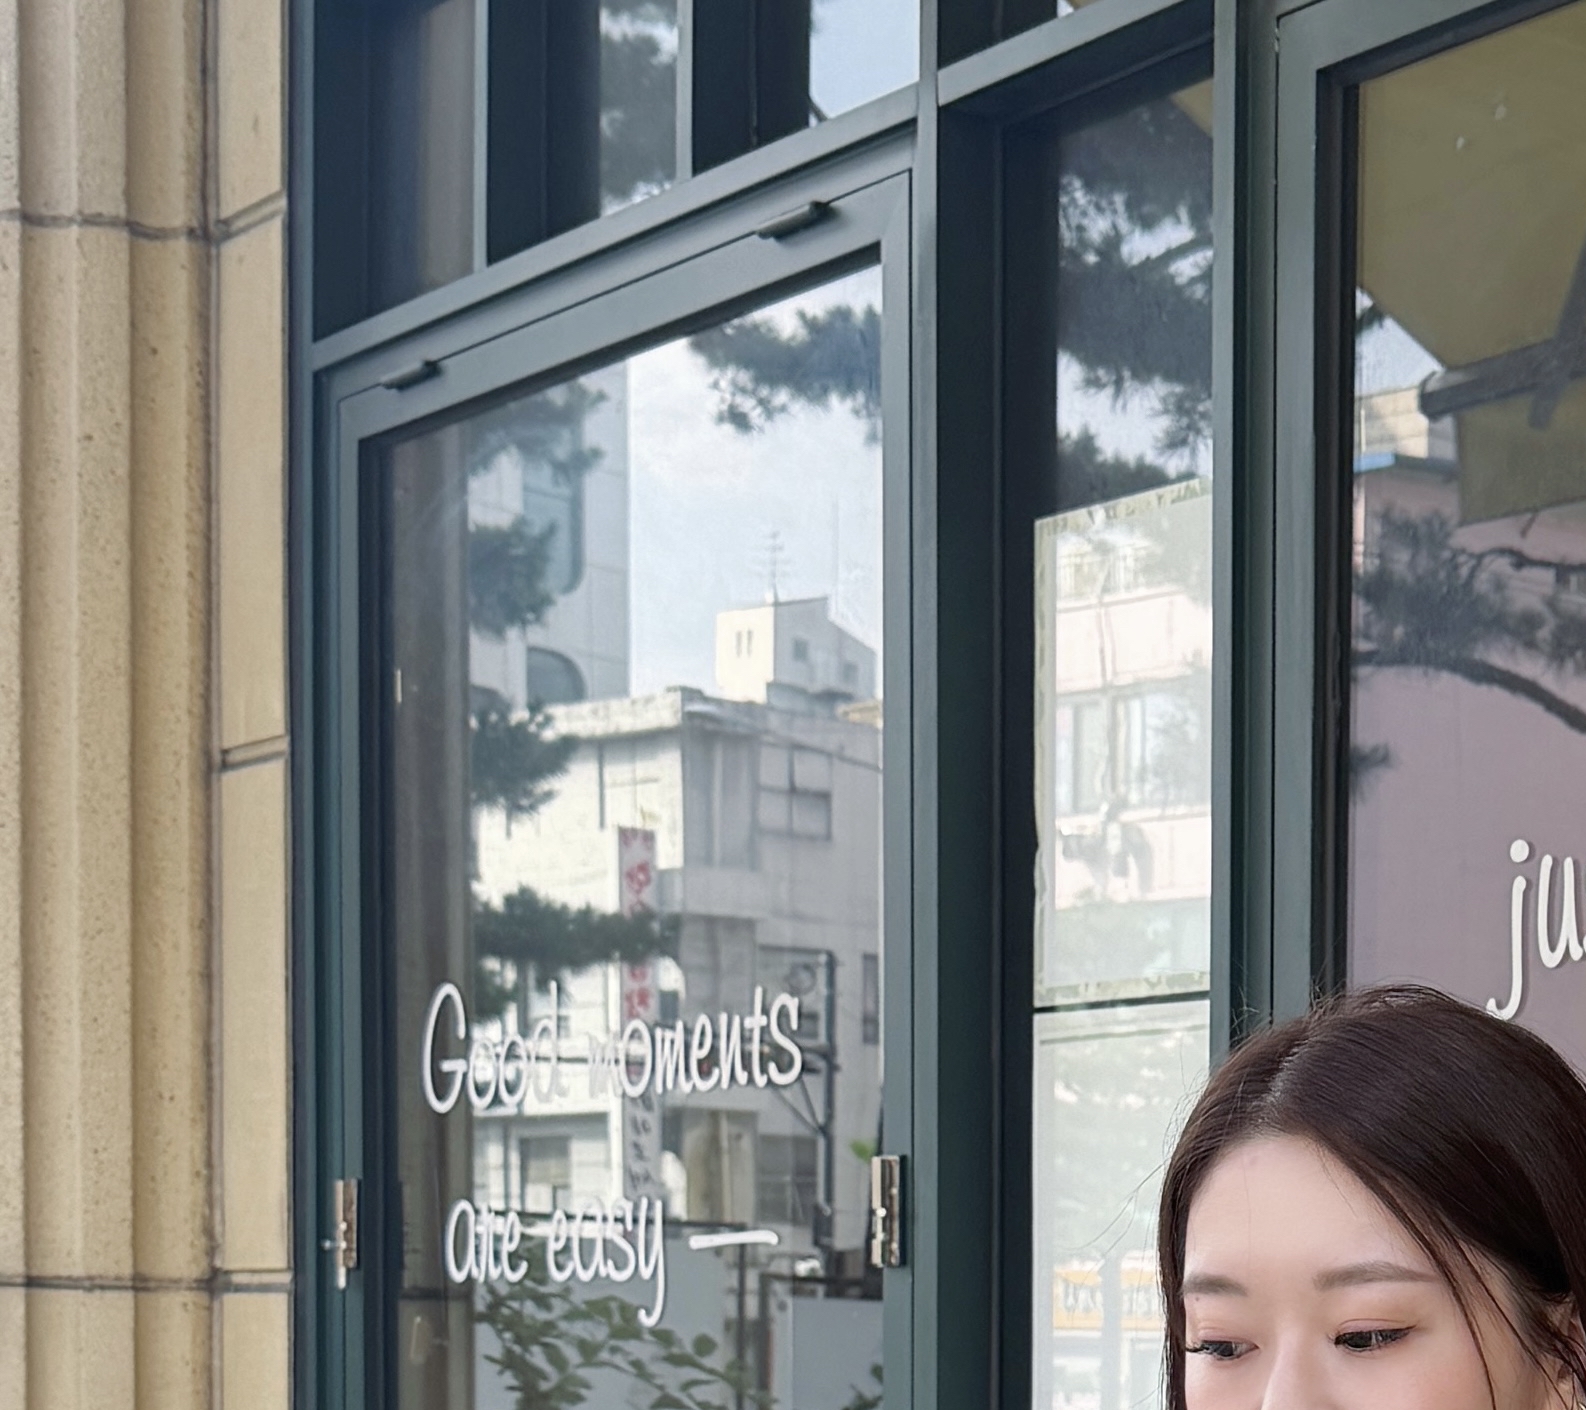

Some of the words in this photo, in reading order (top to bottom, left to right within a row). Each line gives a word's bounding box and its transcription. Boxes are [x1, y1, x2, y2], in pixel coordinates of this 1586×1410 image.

[423, 982, 558, 1113] Good
[445, 1200, 528, 1284] are
[546, 1198, 664, 1327] easy
